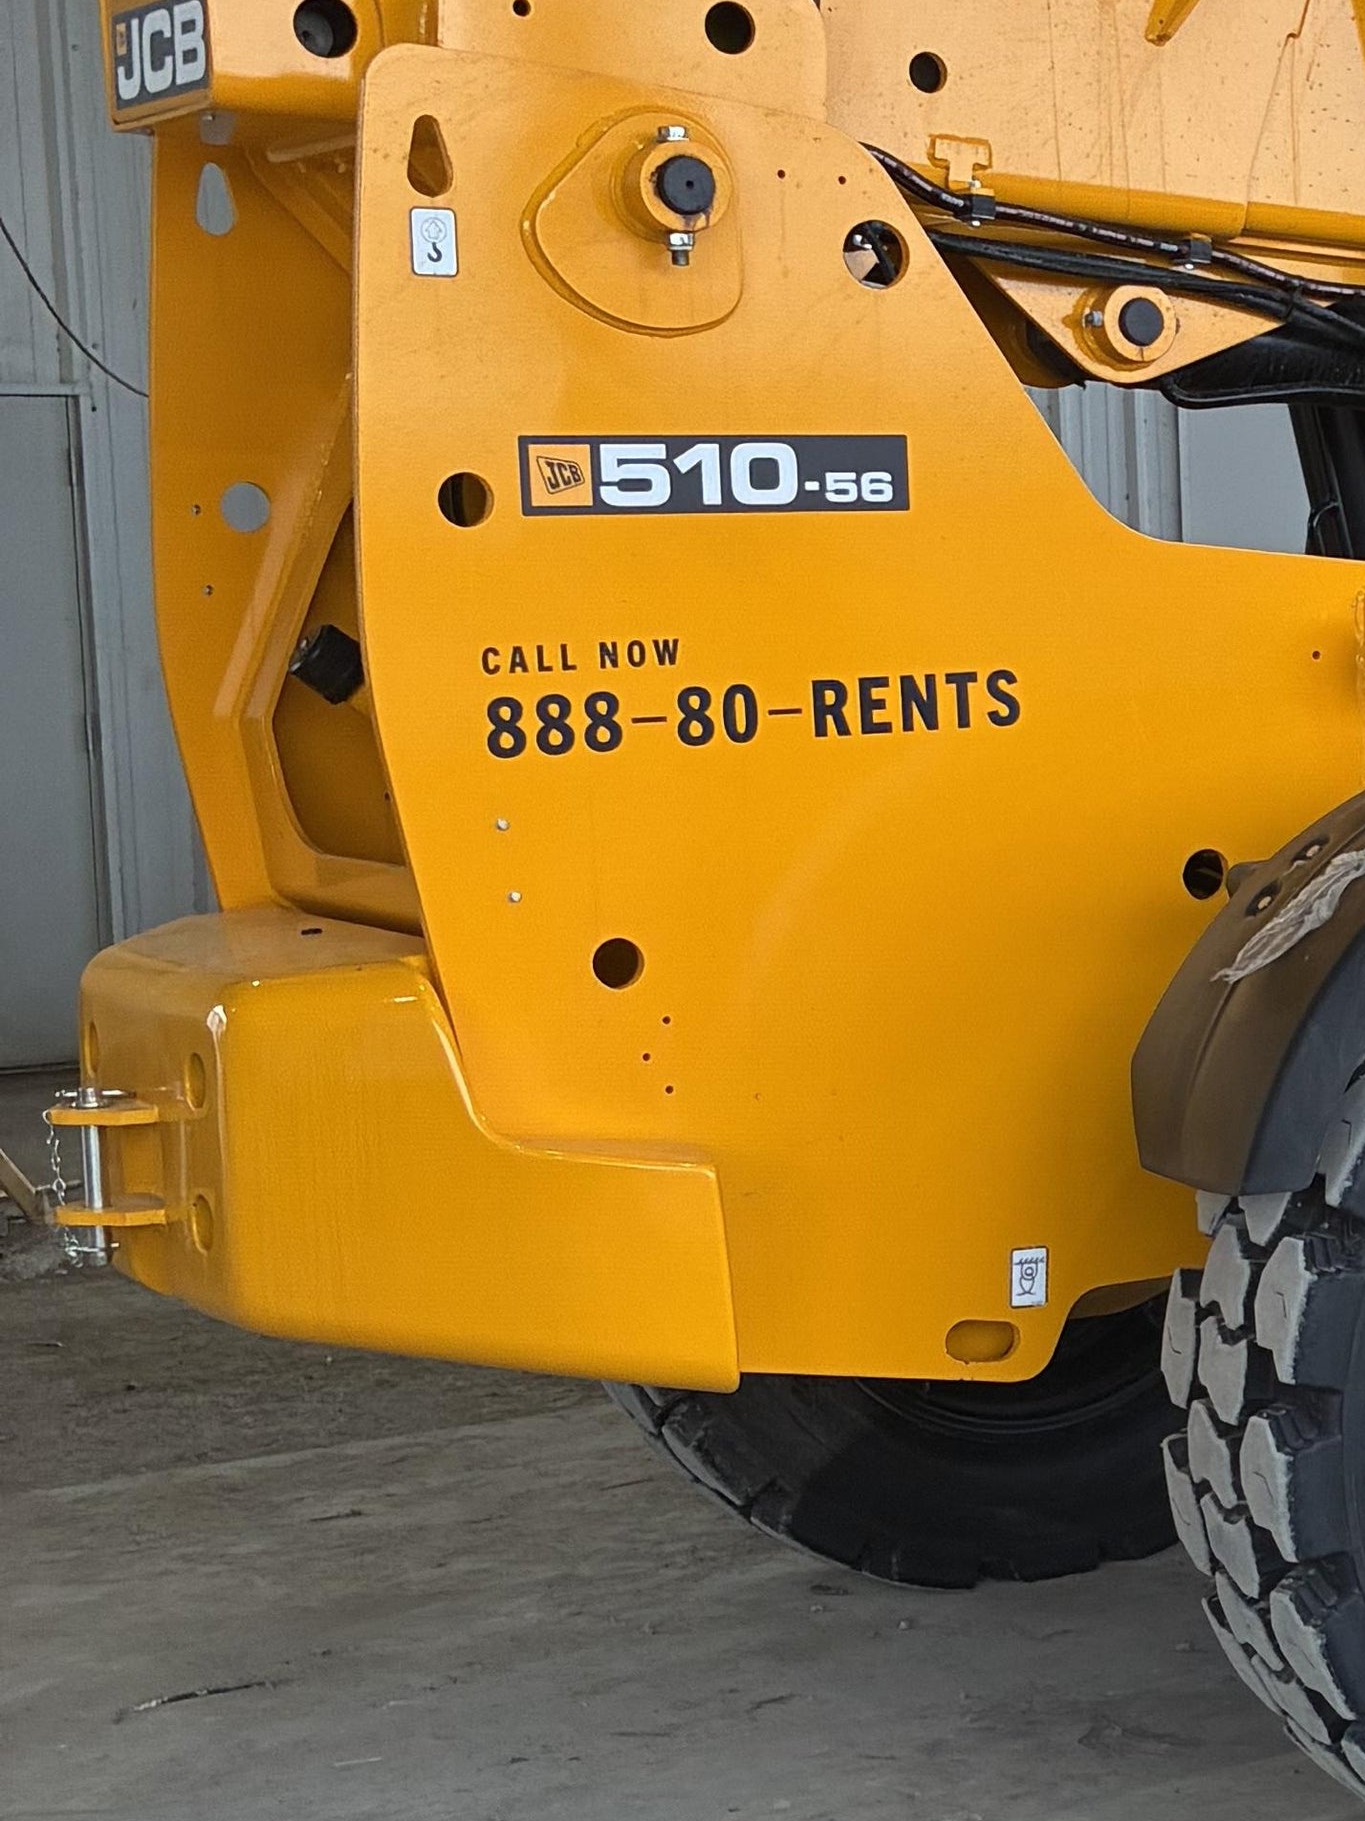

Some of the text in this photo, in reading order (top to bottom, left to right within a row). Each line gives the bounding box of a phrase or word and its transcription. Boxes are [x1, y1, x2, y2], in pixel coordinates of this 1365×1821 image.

[117, 0, 206, 100] JCB
[547, 459, 582, 490] JCB
[599, 442, 894, 507] 510-56
[481, 638, 680, 675] CALL NOW
[486, 668, 1022, 759] 888-80-RENTS
